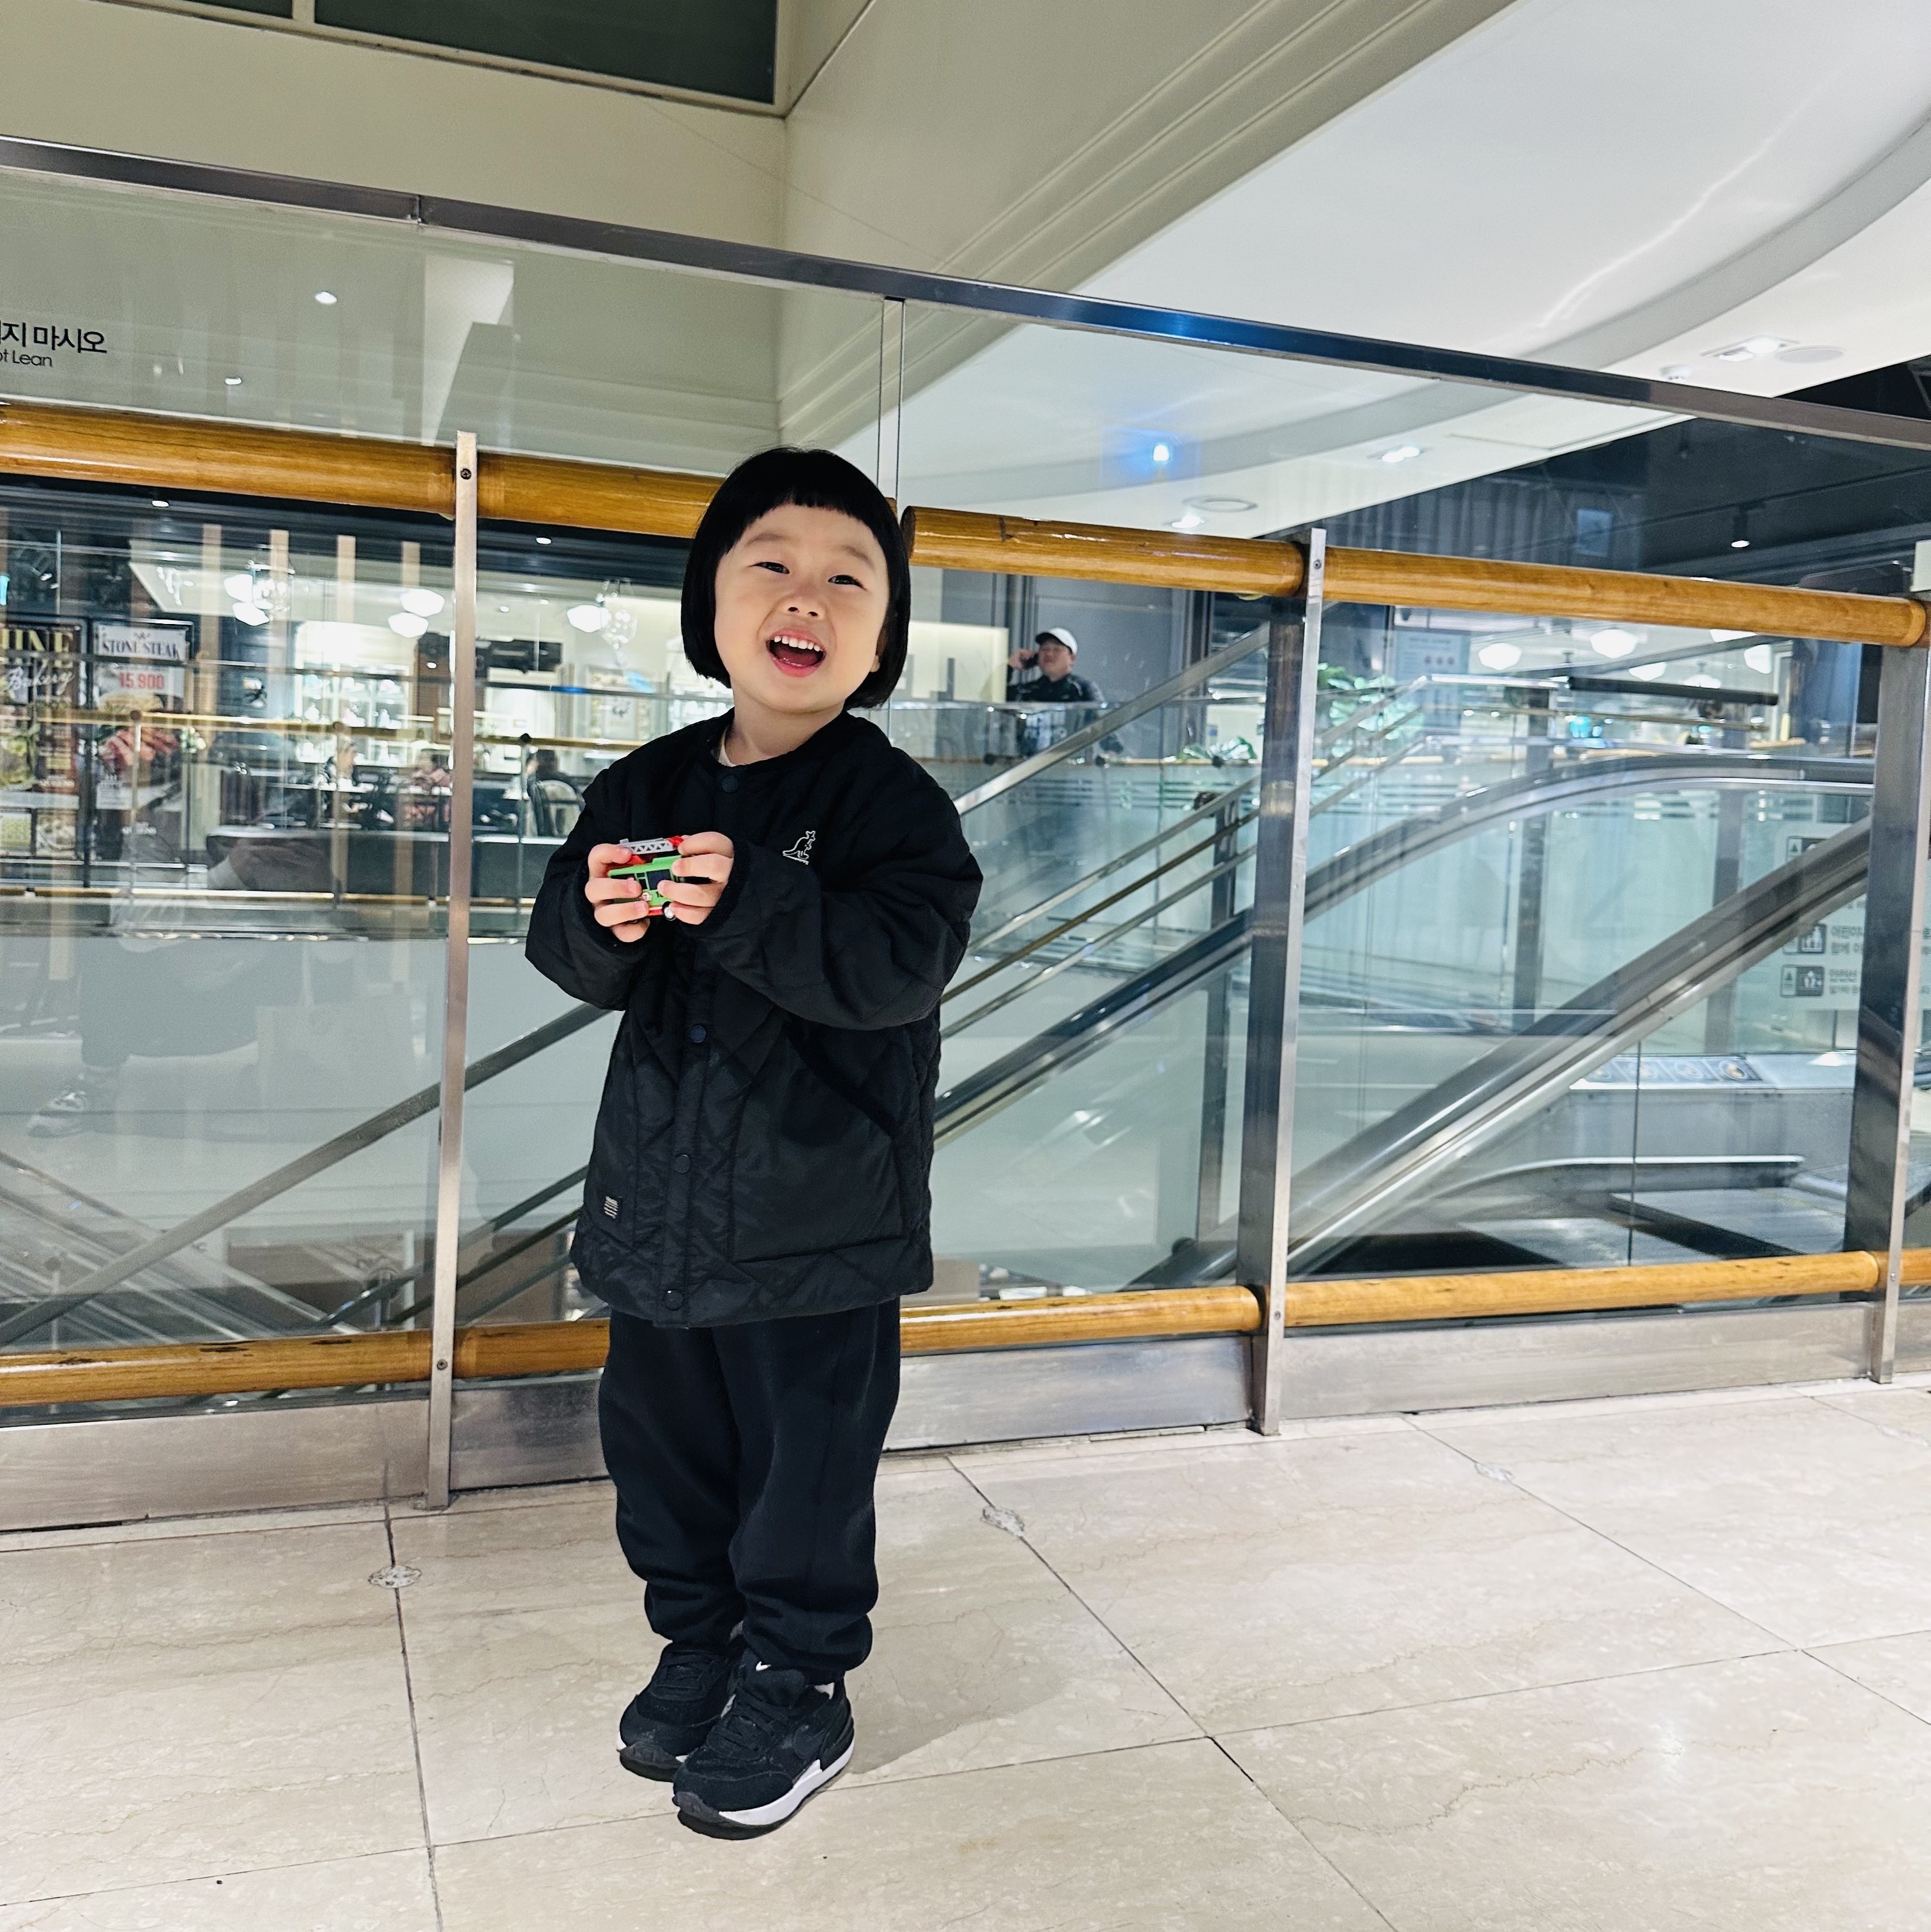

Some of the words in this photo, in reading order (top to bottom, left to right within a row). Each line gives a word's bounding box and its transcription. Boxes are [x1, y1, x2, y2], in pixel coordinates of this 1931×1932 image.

[0, 320, 26, 347] 지
[34, 326, 107, 354] 마시오
[13, 349, 52, 367] Lean
